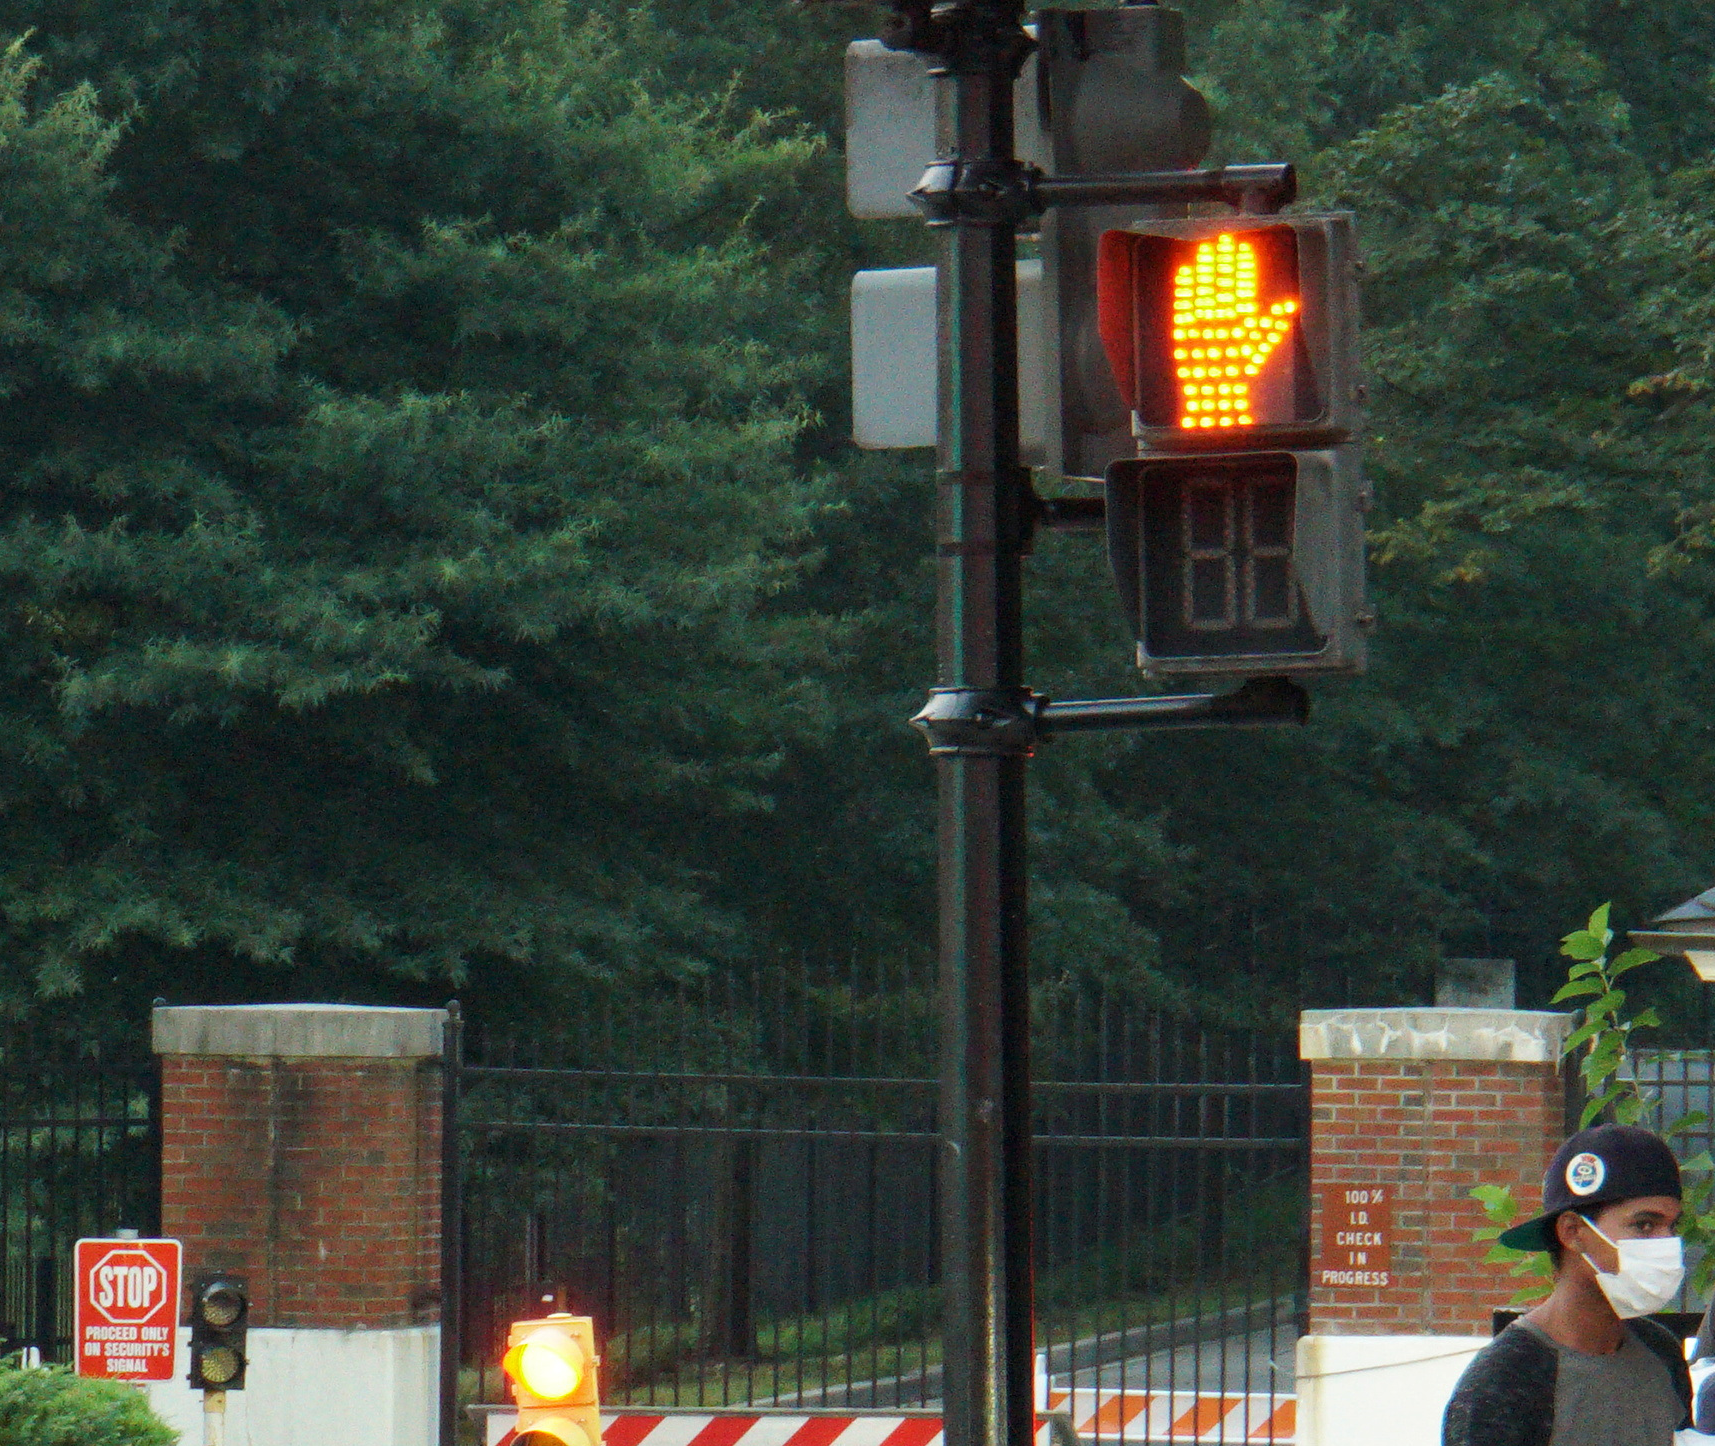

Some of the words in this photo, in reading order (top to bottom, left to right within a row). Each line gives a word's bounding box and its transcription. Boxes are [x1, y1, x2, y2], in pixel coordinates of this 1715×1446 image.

[1336, 1231, 1382, 1246] CHECK
[1349, 1251, 1367, 1265] IN
[1322, 1270, 1389, 1286] PROGRESS
[99, 1265, 158, 1308] STOP
[86, 1326, 137, 1340] PROCEED
[141, 1327, 169, 1340] ONLY
[84, 1342, 101, 1356] ON
[104, 1343, 170, 1357] SECURITY'S
[106, 1358, 148, 1372] SIGNAL
